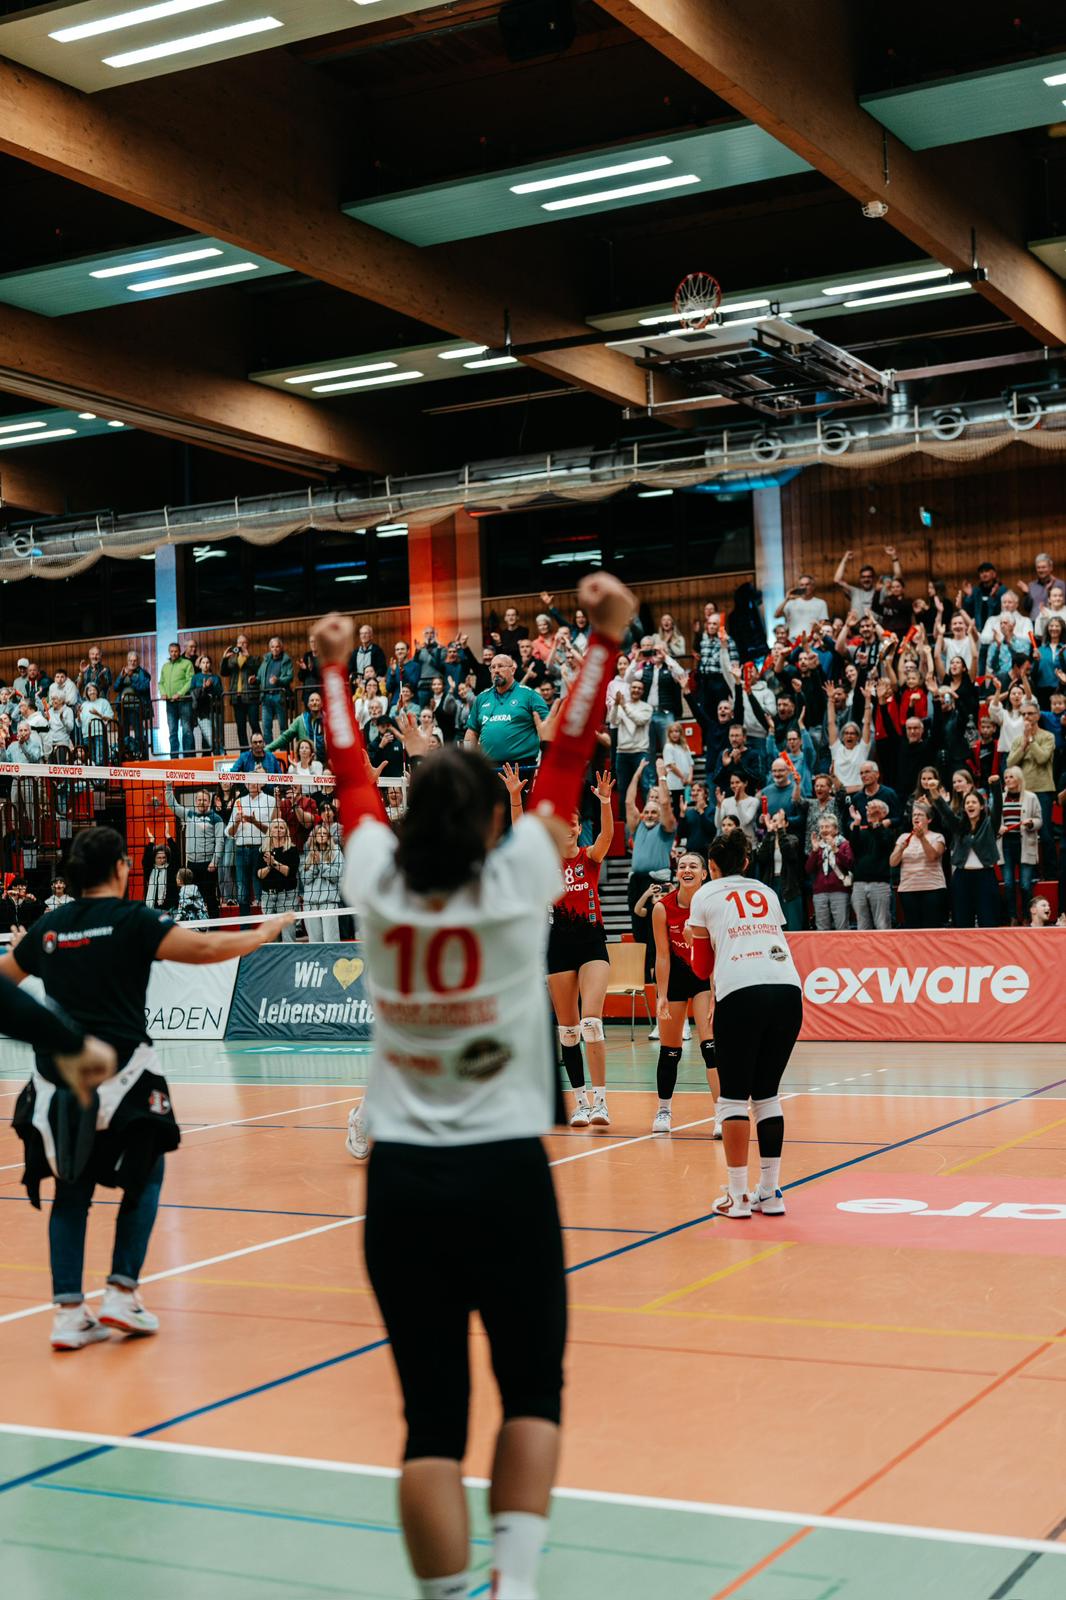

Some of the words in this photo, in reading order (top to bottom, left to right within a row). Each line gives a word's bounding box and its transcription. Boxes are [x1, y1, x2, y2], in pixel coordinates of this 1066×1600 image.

[0, 763, 20, 773] ware
[49, 766, 83, 776] Lexware
[109, 768, 142, 778] Lexware
[165, 770, 196, 780] Lexware
[218, 773, 247, 782] Lexware
[267, 774, 294, 783] Lexware
[313, 776, 336, 784] Lexwar
[725, 889, 769, 919] 19
[728, 924, 752, 934] BLACK
[753, 923, 778, 932] FOREST
[384, 924, 482, 997] 10
[294, 961, 328, 988] Wir
[803, 964, 1030, 1004] exware
[258, 997, 375, 1024] Lebensmitte
[836, 1198, 1066, 1220] are
